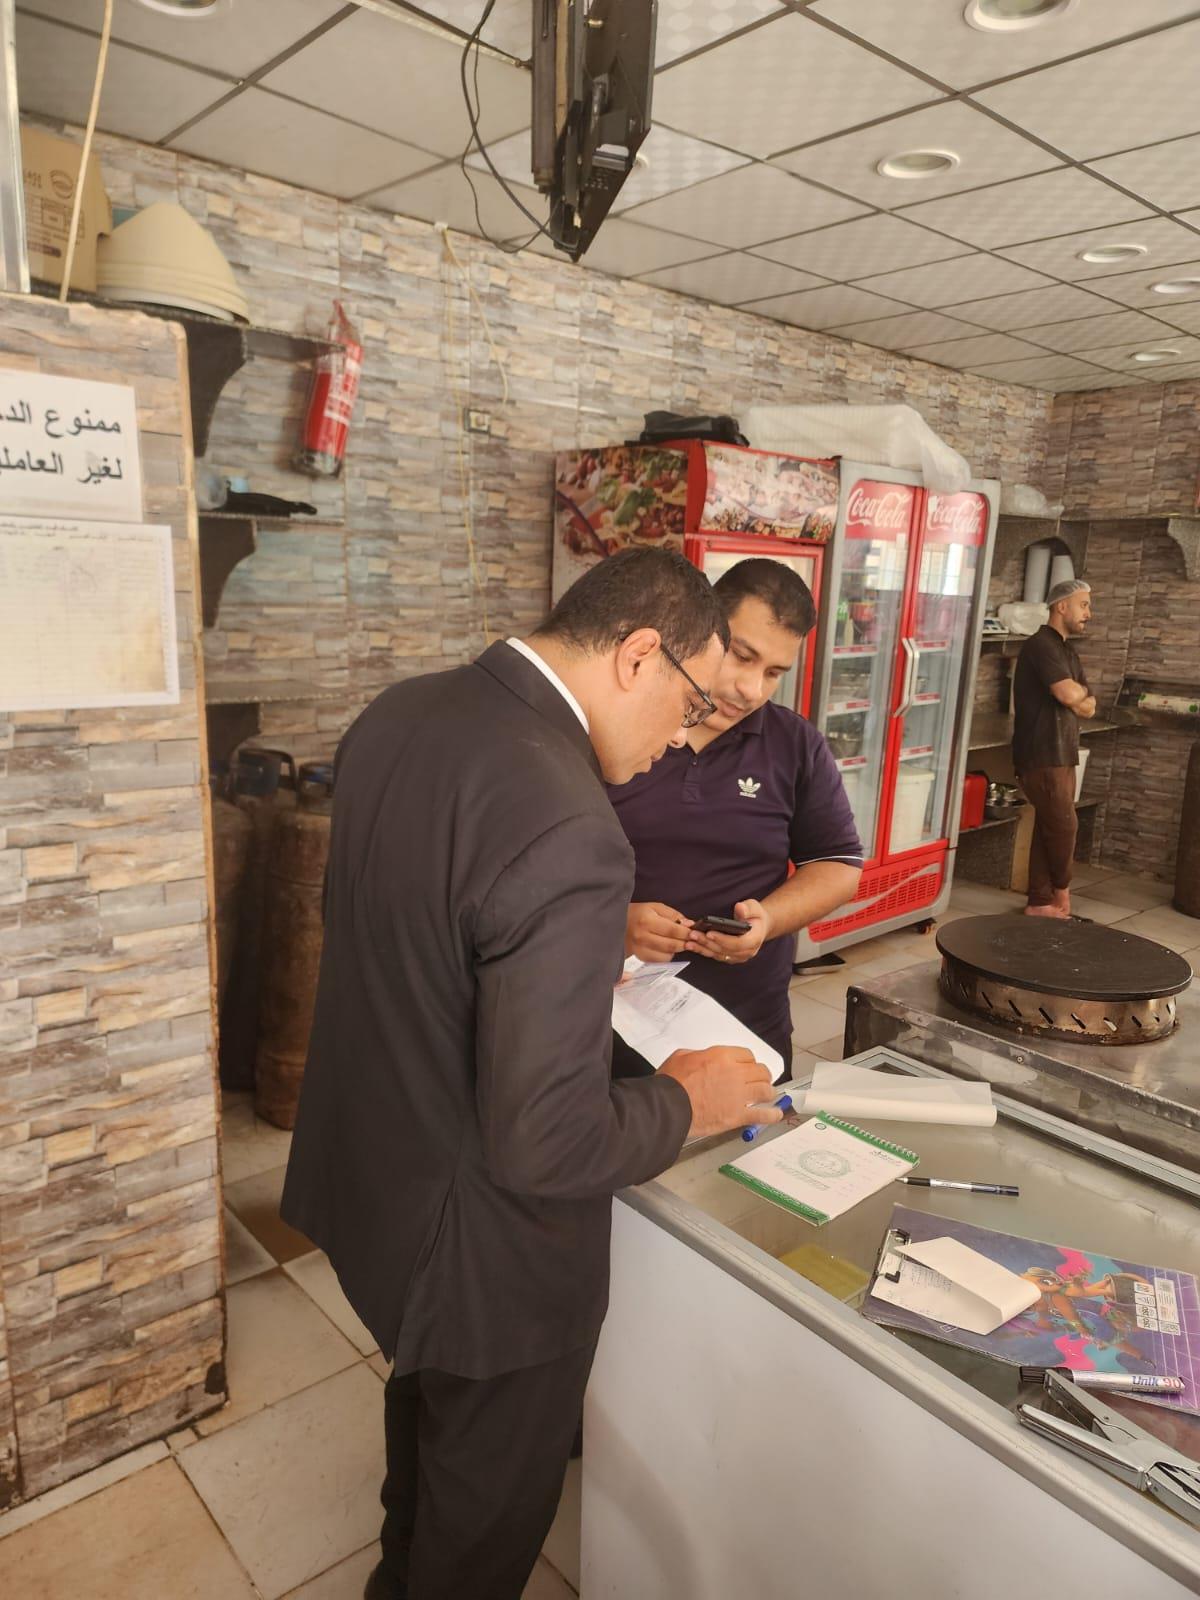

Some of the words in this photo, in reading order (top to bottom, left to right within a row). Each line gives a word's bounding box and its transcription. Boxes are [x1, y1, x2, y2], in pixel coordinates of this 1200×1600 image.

[0, 399, 32, 424] الد
[45, 408, 122, 438] ممنوع
[76, 456, 123, 484] لغير
